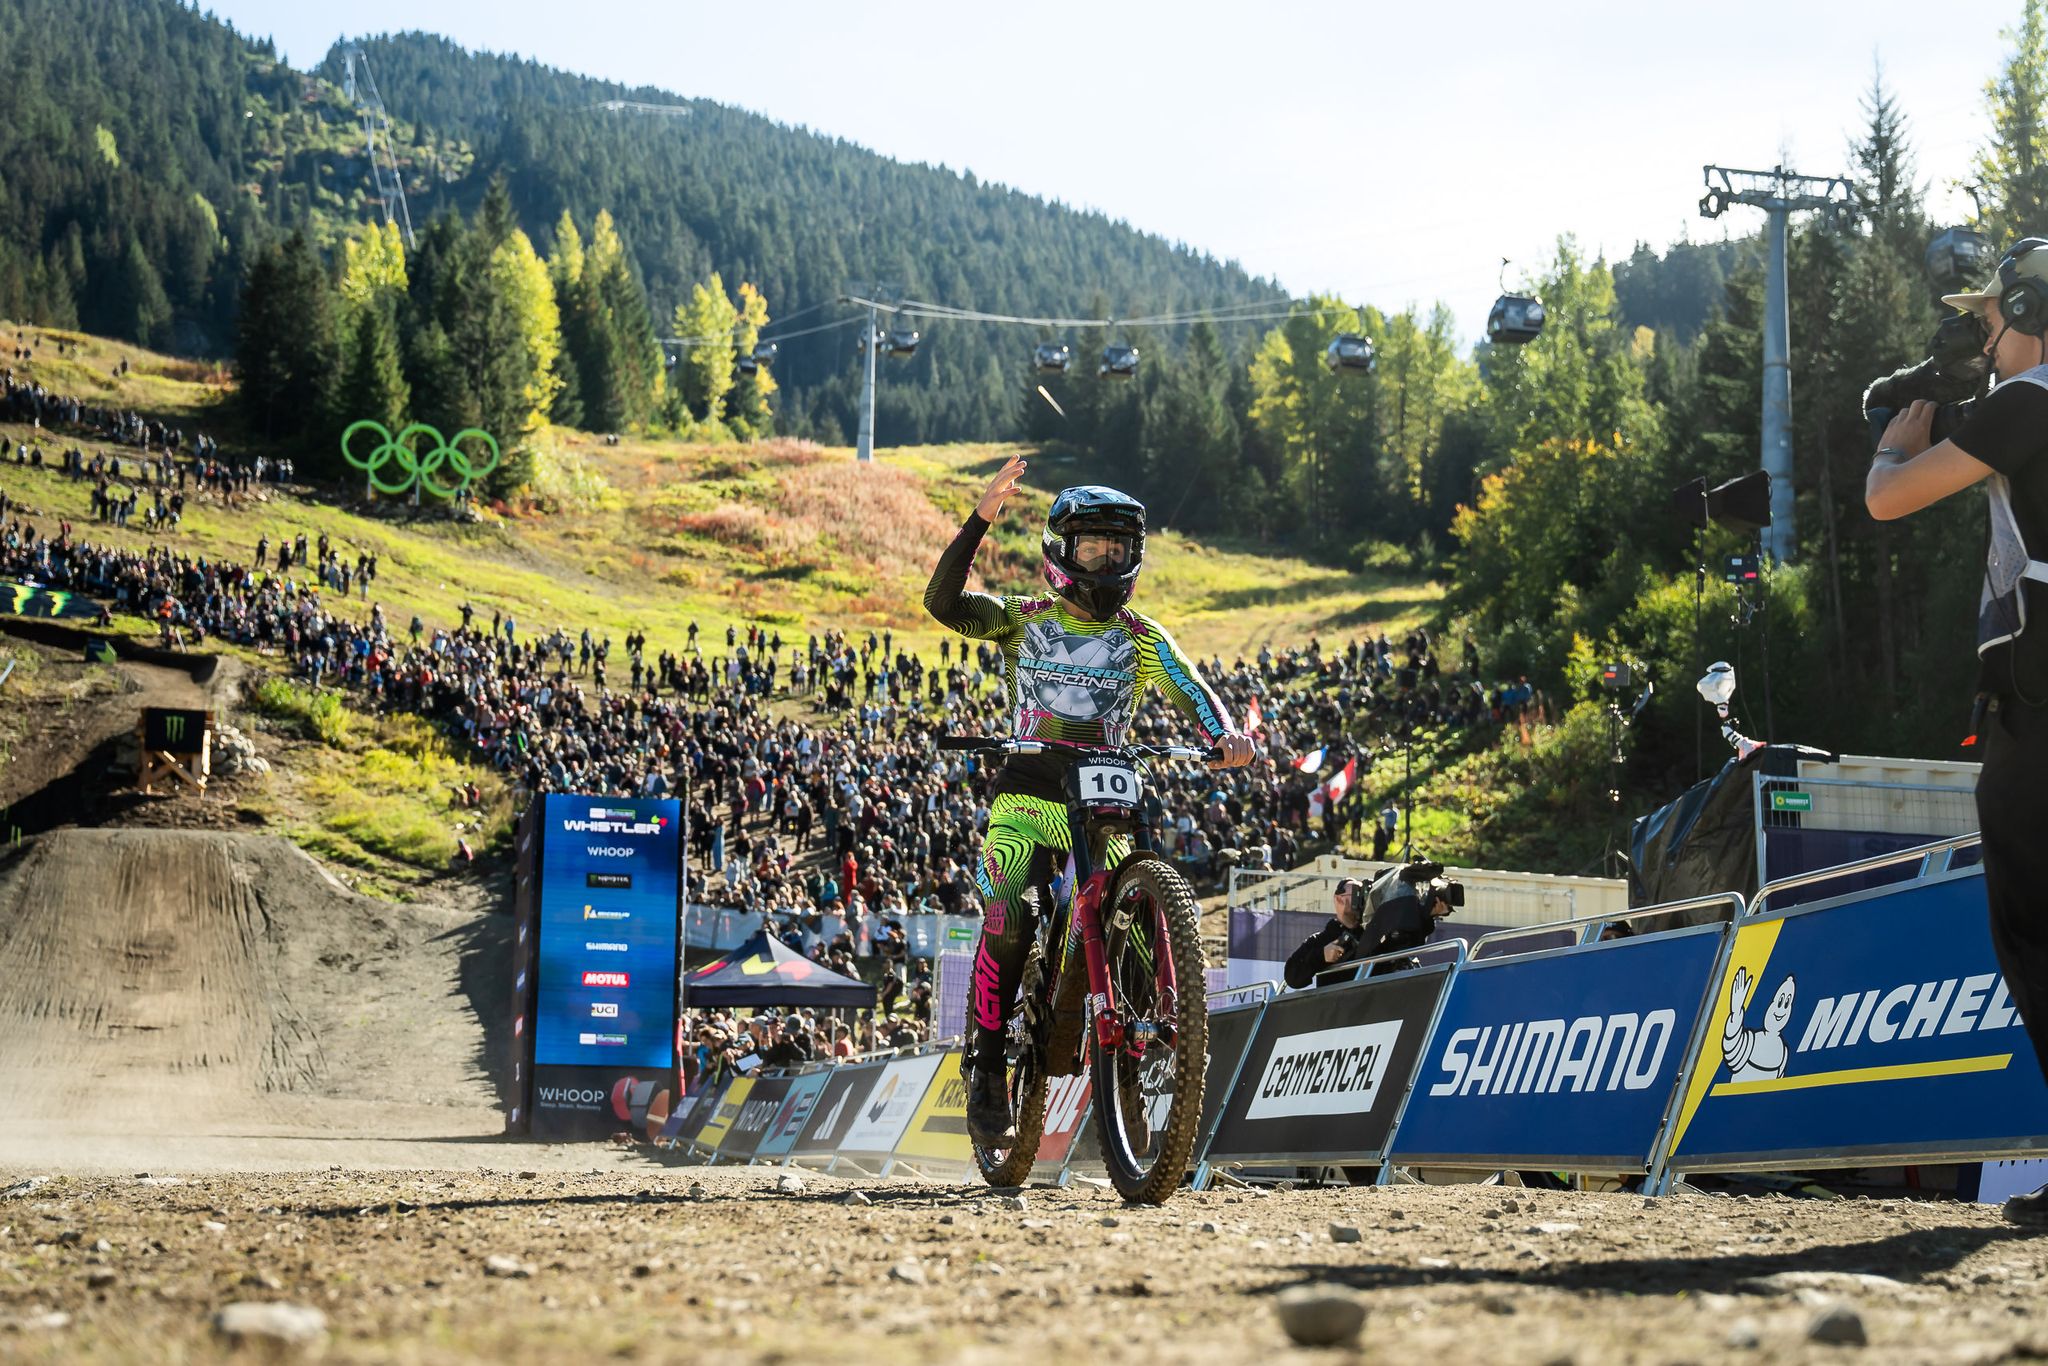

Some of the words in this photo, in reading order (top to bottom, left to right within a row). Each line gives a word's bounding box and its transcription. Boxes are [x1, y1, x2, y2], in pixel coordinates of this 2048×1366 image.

[1018, 657, 1137, 683] NUKEPROOF
[1033, 669, 1119, 691] RACING
[1088, 757, 1127, 767] WHOOP
[1091, 772, 1128, 795] 10
[563, 819, 661, 835] WHISTLER
[587, 846, 635, 858] WHOOP
[586, 942, 629, 952] SHIMANO
[584, 973, 628, 986] MOTUL
[596, 1006, 616, 1015] UCI
[1796, 972, 2025, 1054] MICHEL
[1428, 1008, 1677, 1097] SHIMANO
[1262, 1044, 1382, 1099] COMMENCAL
[539, 1087, 605, 1103] WHOOP
